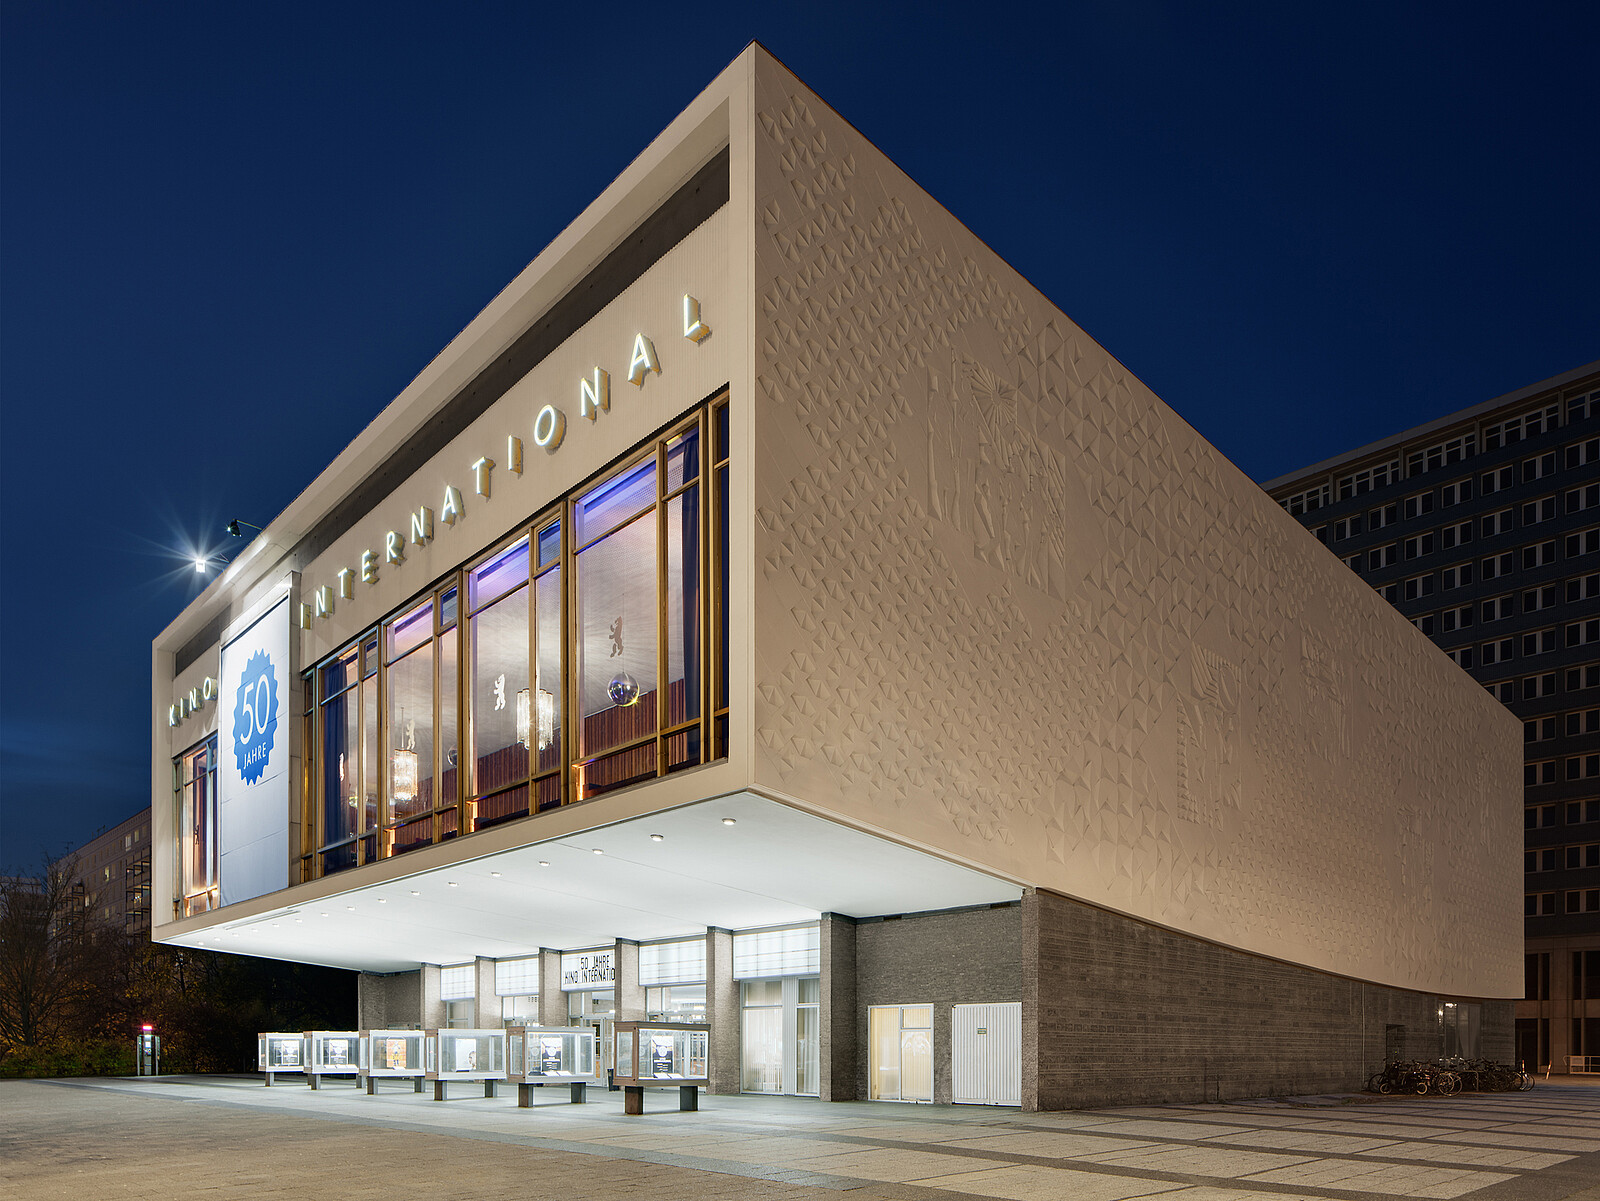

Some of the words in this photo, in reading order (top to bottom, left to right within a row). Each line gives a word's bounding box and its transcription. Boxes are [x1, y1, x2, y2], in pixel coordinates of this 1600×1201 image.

[300, 293, 709, 629] INTERNATIONAL
[169, 676, 216, 728] KINO
[240, 673, 270, 745] 50
[243, 742, 267, 770] JAHRE
[565, 971, 578, 984] KINO
[581, 957, 588, 970] 50
[592, 955, 609, 969] JAHRE
